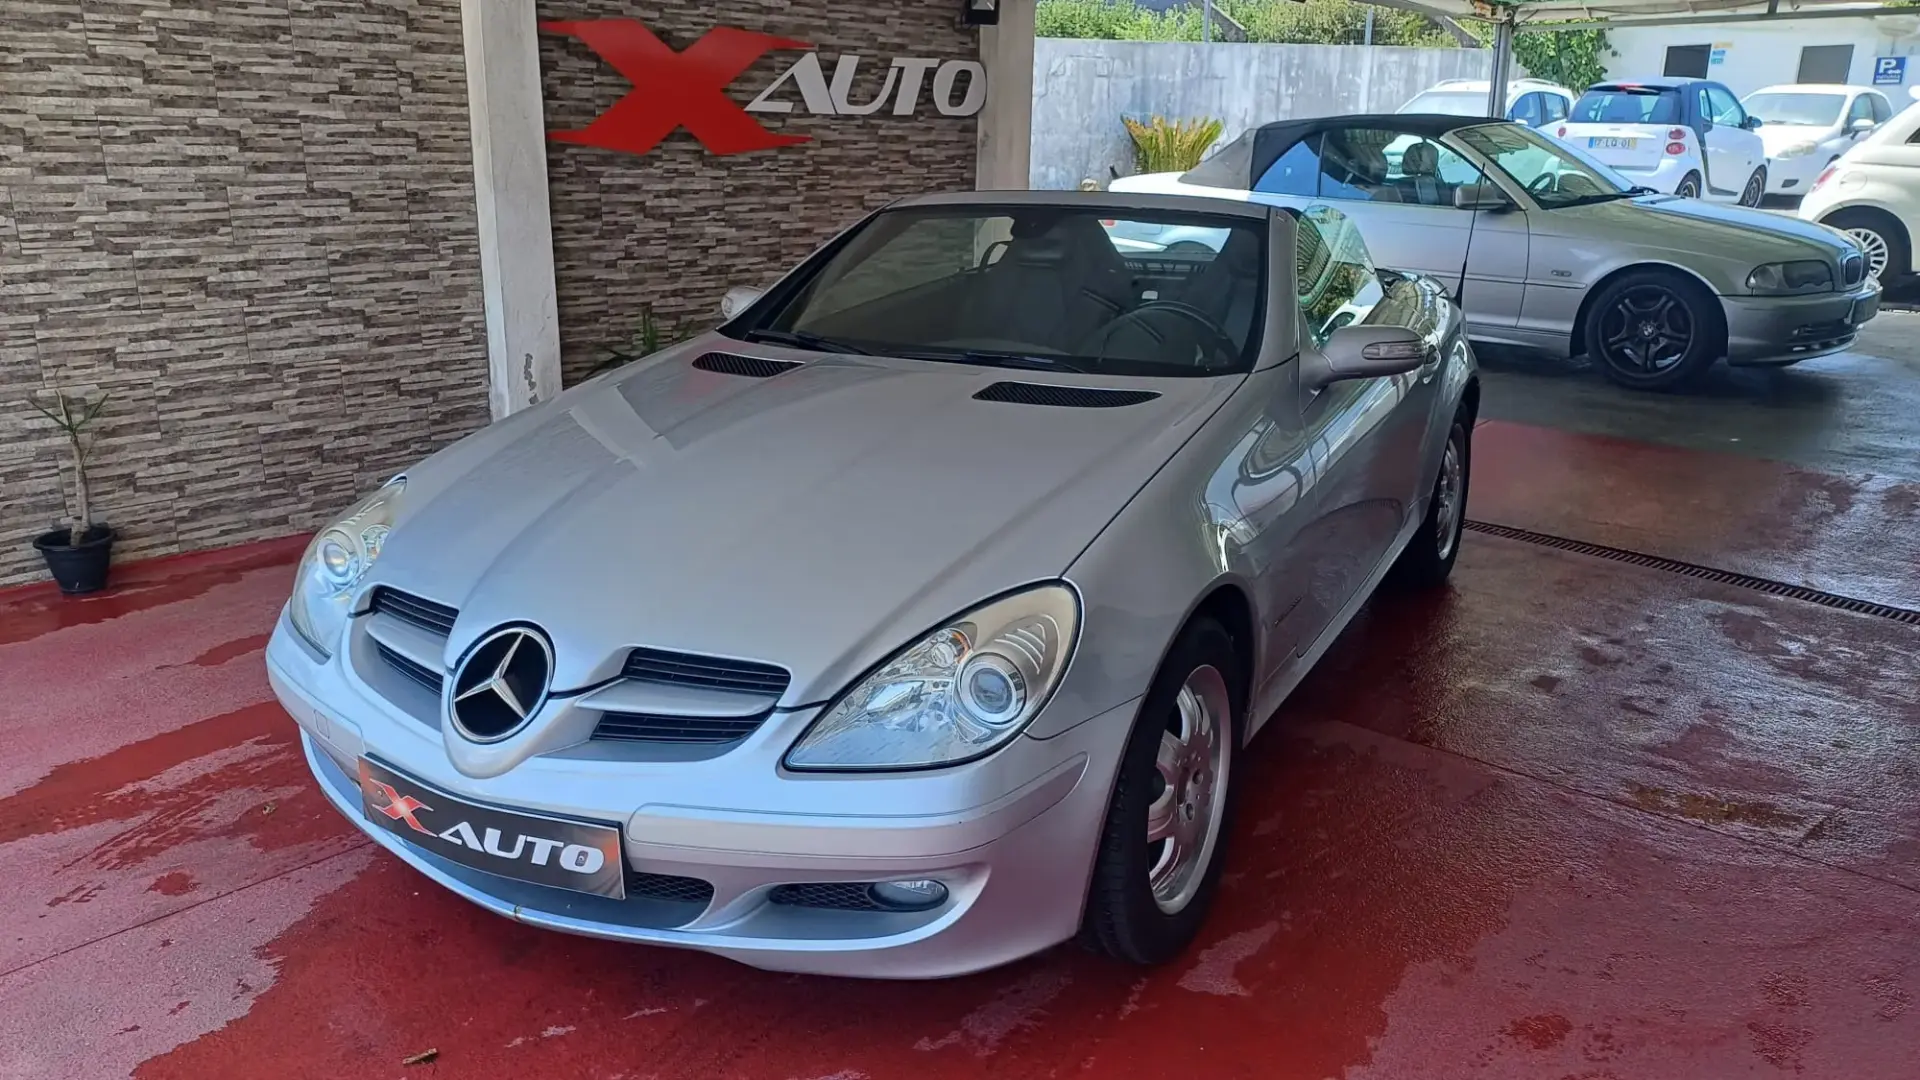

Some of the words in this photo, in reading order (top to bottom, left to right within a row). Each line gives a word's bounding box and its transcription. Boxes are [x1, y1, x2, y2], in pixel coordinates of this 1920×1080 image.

[743, 51, 988, 117] AUTO
[1879, 59, 1897, 73] P
[438, 820, 605, 875] AUTO
